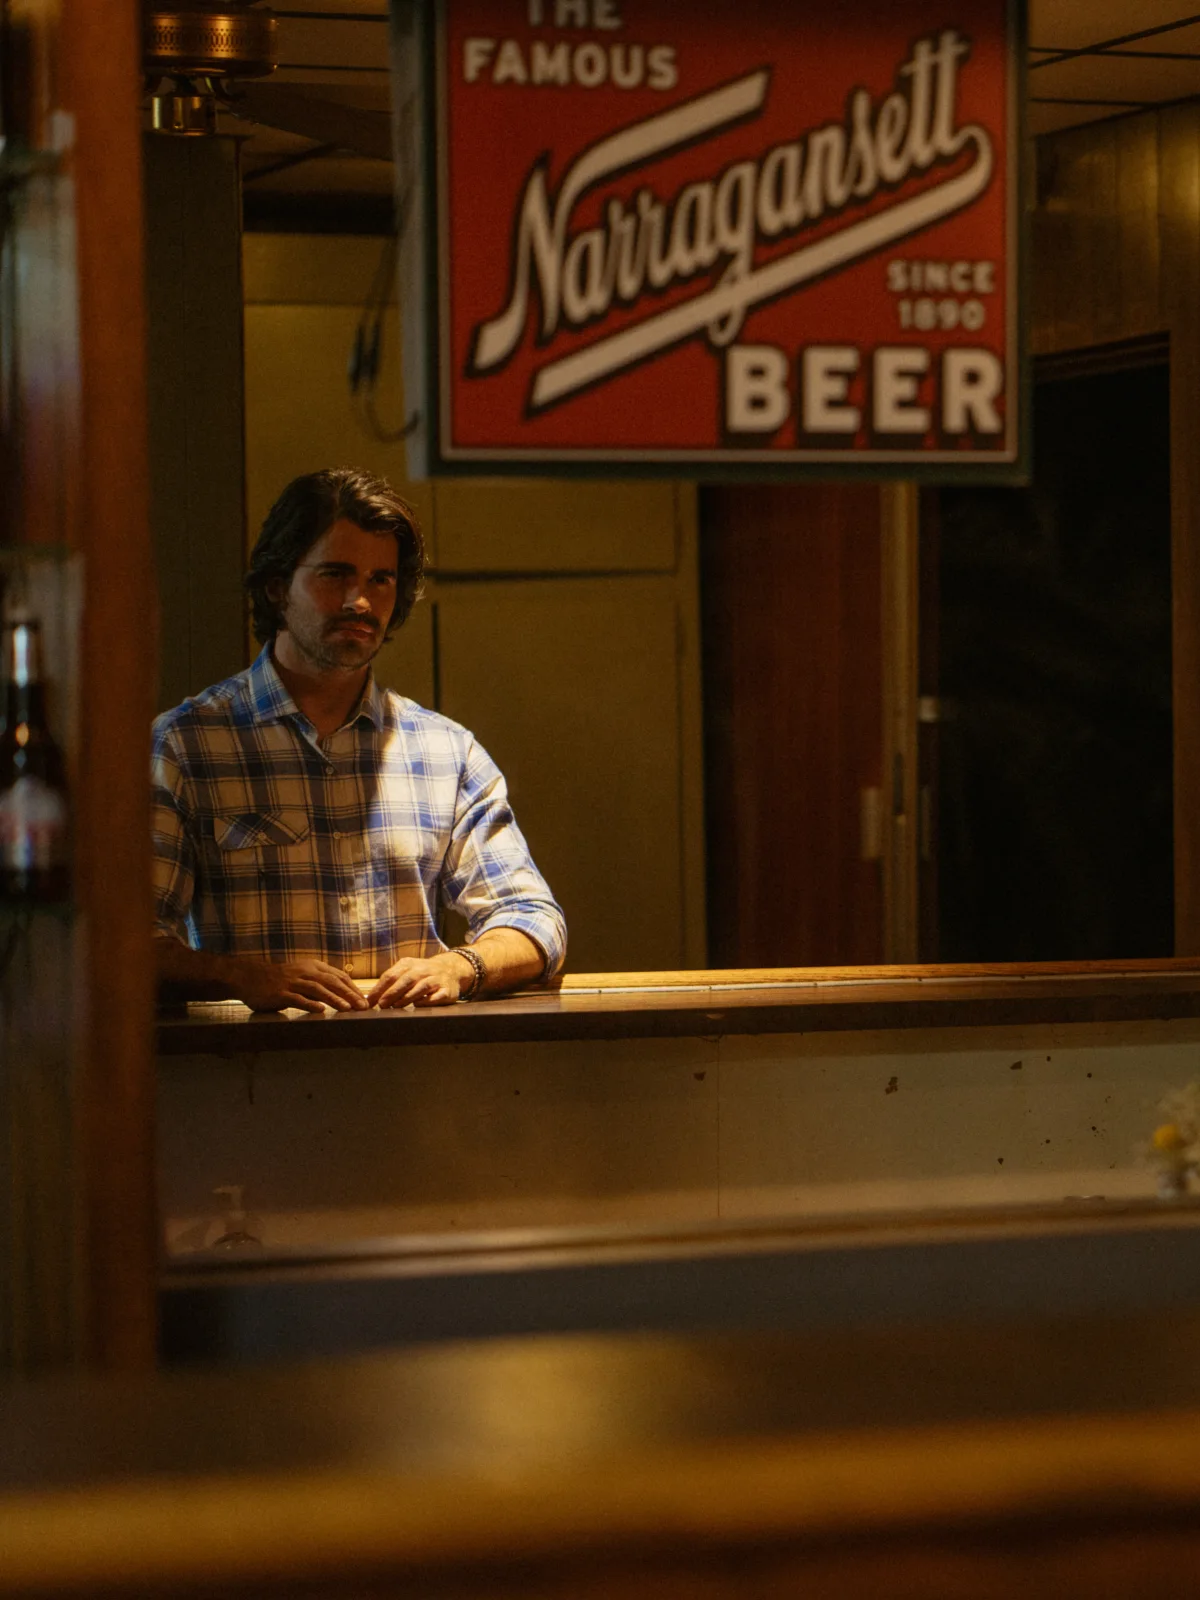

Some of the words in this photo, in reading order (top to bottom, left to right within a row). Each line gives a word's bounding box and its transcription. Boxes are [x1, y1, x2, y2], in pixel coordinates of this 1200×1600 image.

[462, 37, 679, 91] FAMOUS
[473, 32, 993, 409] Narragansett
[887, 259, 995, 295] SINCE
[897, 297, 986, 332] 1890
[725, 345, 1003, 435] BEER
